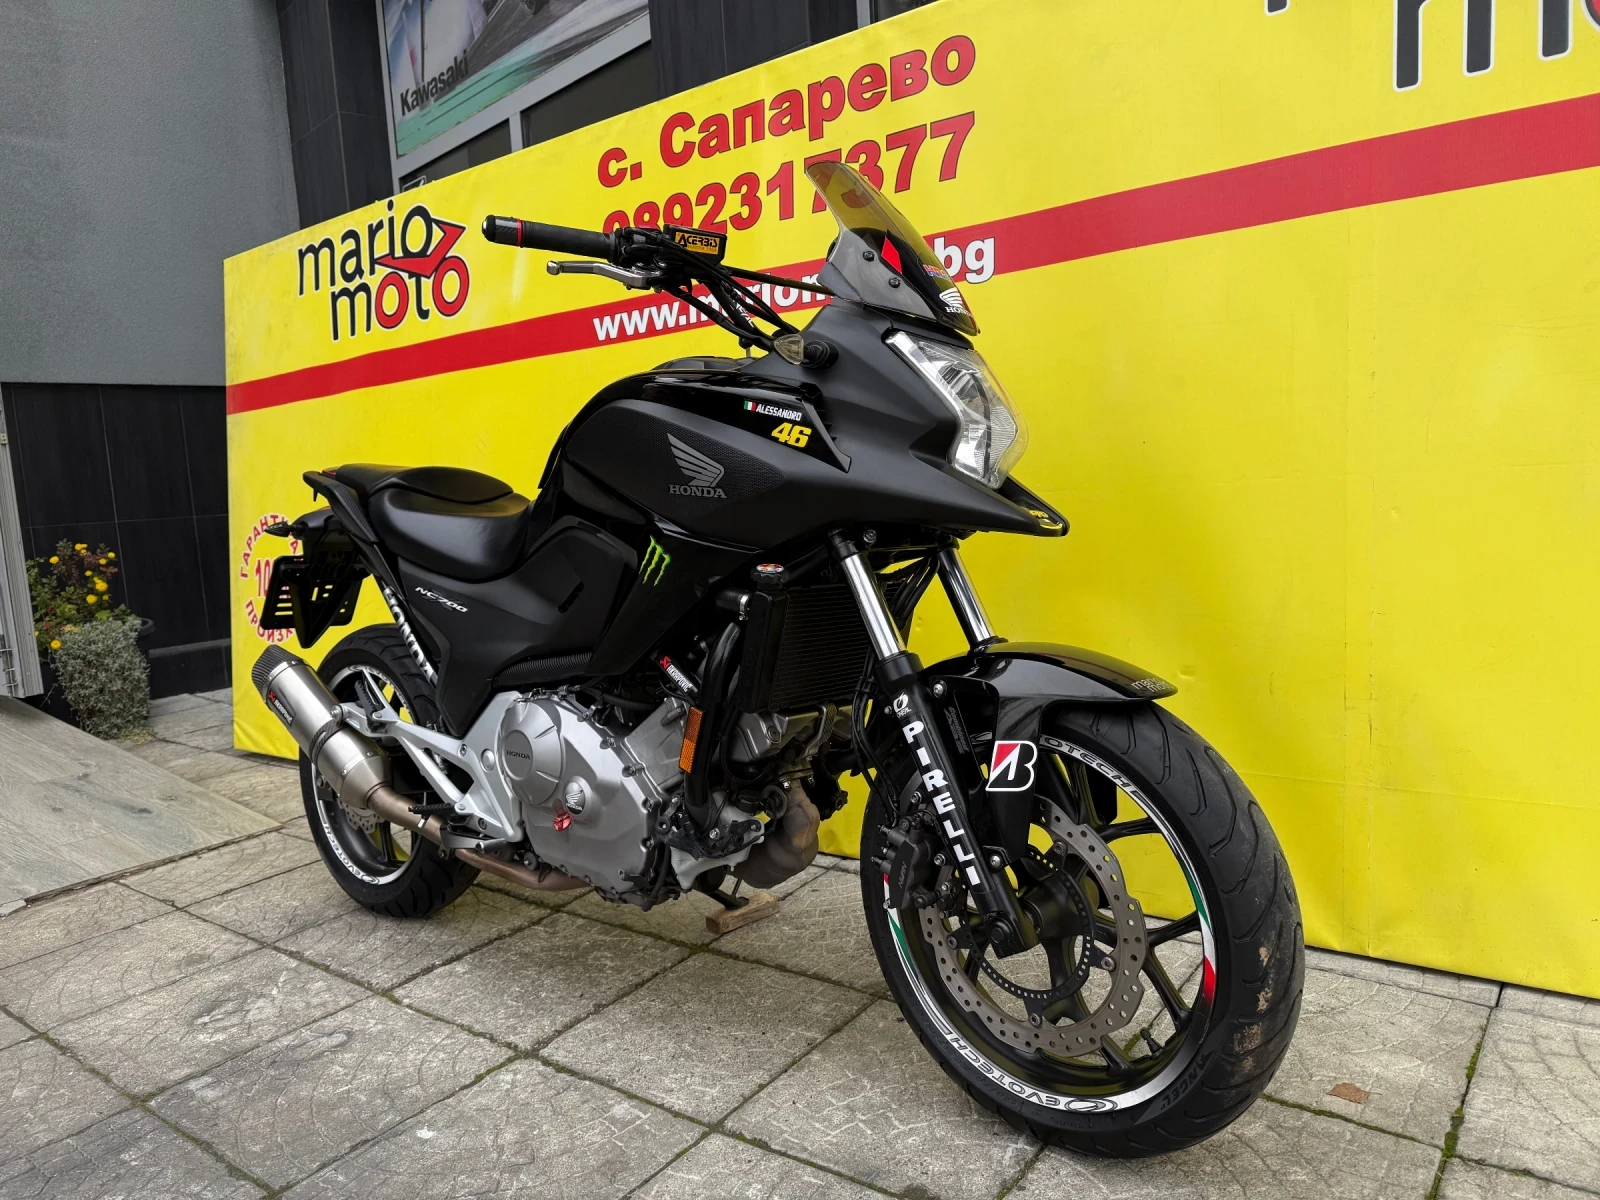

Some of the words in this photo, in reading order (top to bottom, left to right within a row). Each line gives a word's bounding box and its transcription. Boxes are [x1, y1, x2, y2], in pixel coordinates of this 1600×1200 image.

[400, 50, 468, 116] Kawasaki
[659, 35, 976, 168] Сапарево
[298, 199, 434, 296] mario
[677, 233, 718, 249] ACERBIS
[331, 254, 470, 342] moto
[756, 403, 802, 421] ALESSANDRO
[771, 422, 812, 448] 46
[668, 484, 728, 499] HONDA
[415, 587, 468, 613] NC700
[506, 750, 531, 760] HONDA
[1044, 737, 1132, 788] OTECH
[902, 720, 981, 886] PIRELLI
[950, 1037, 1061, 1107] EVOTECH
